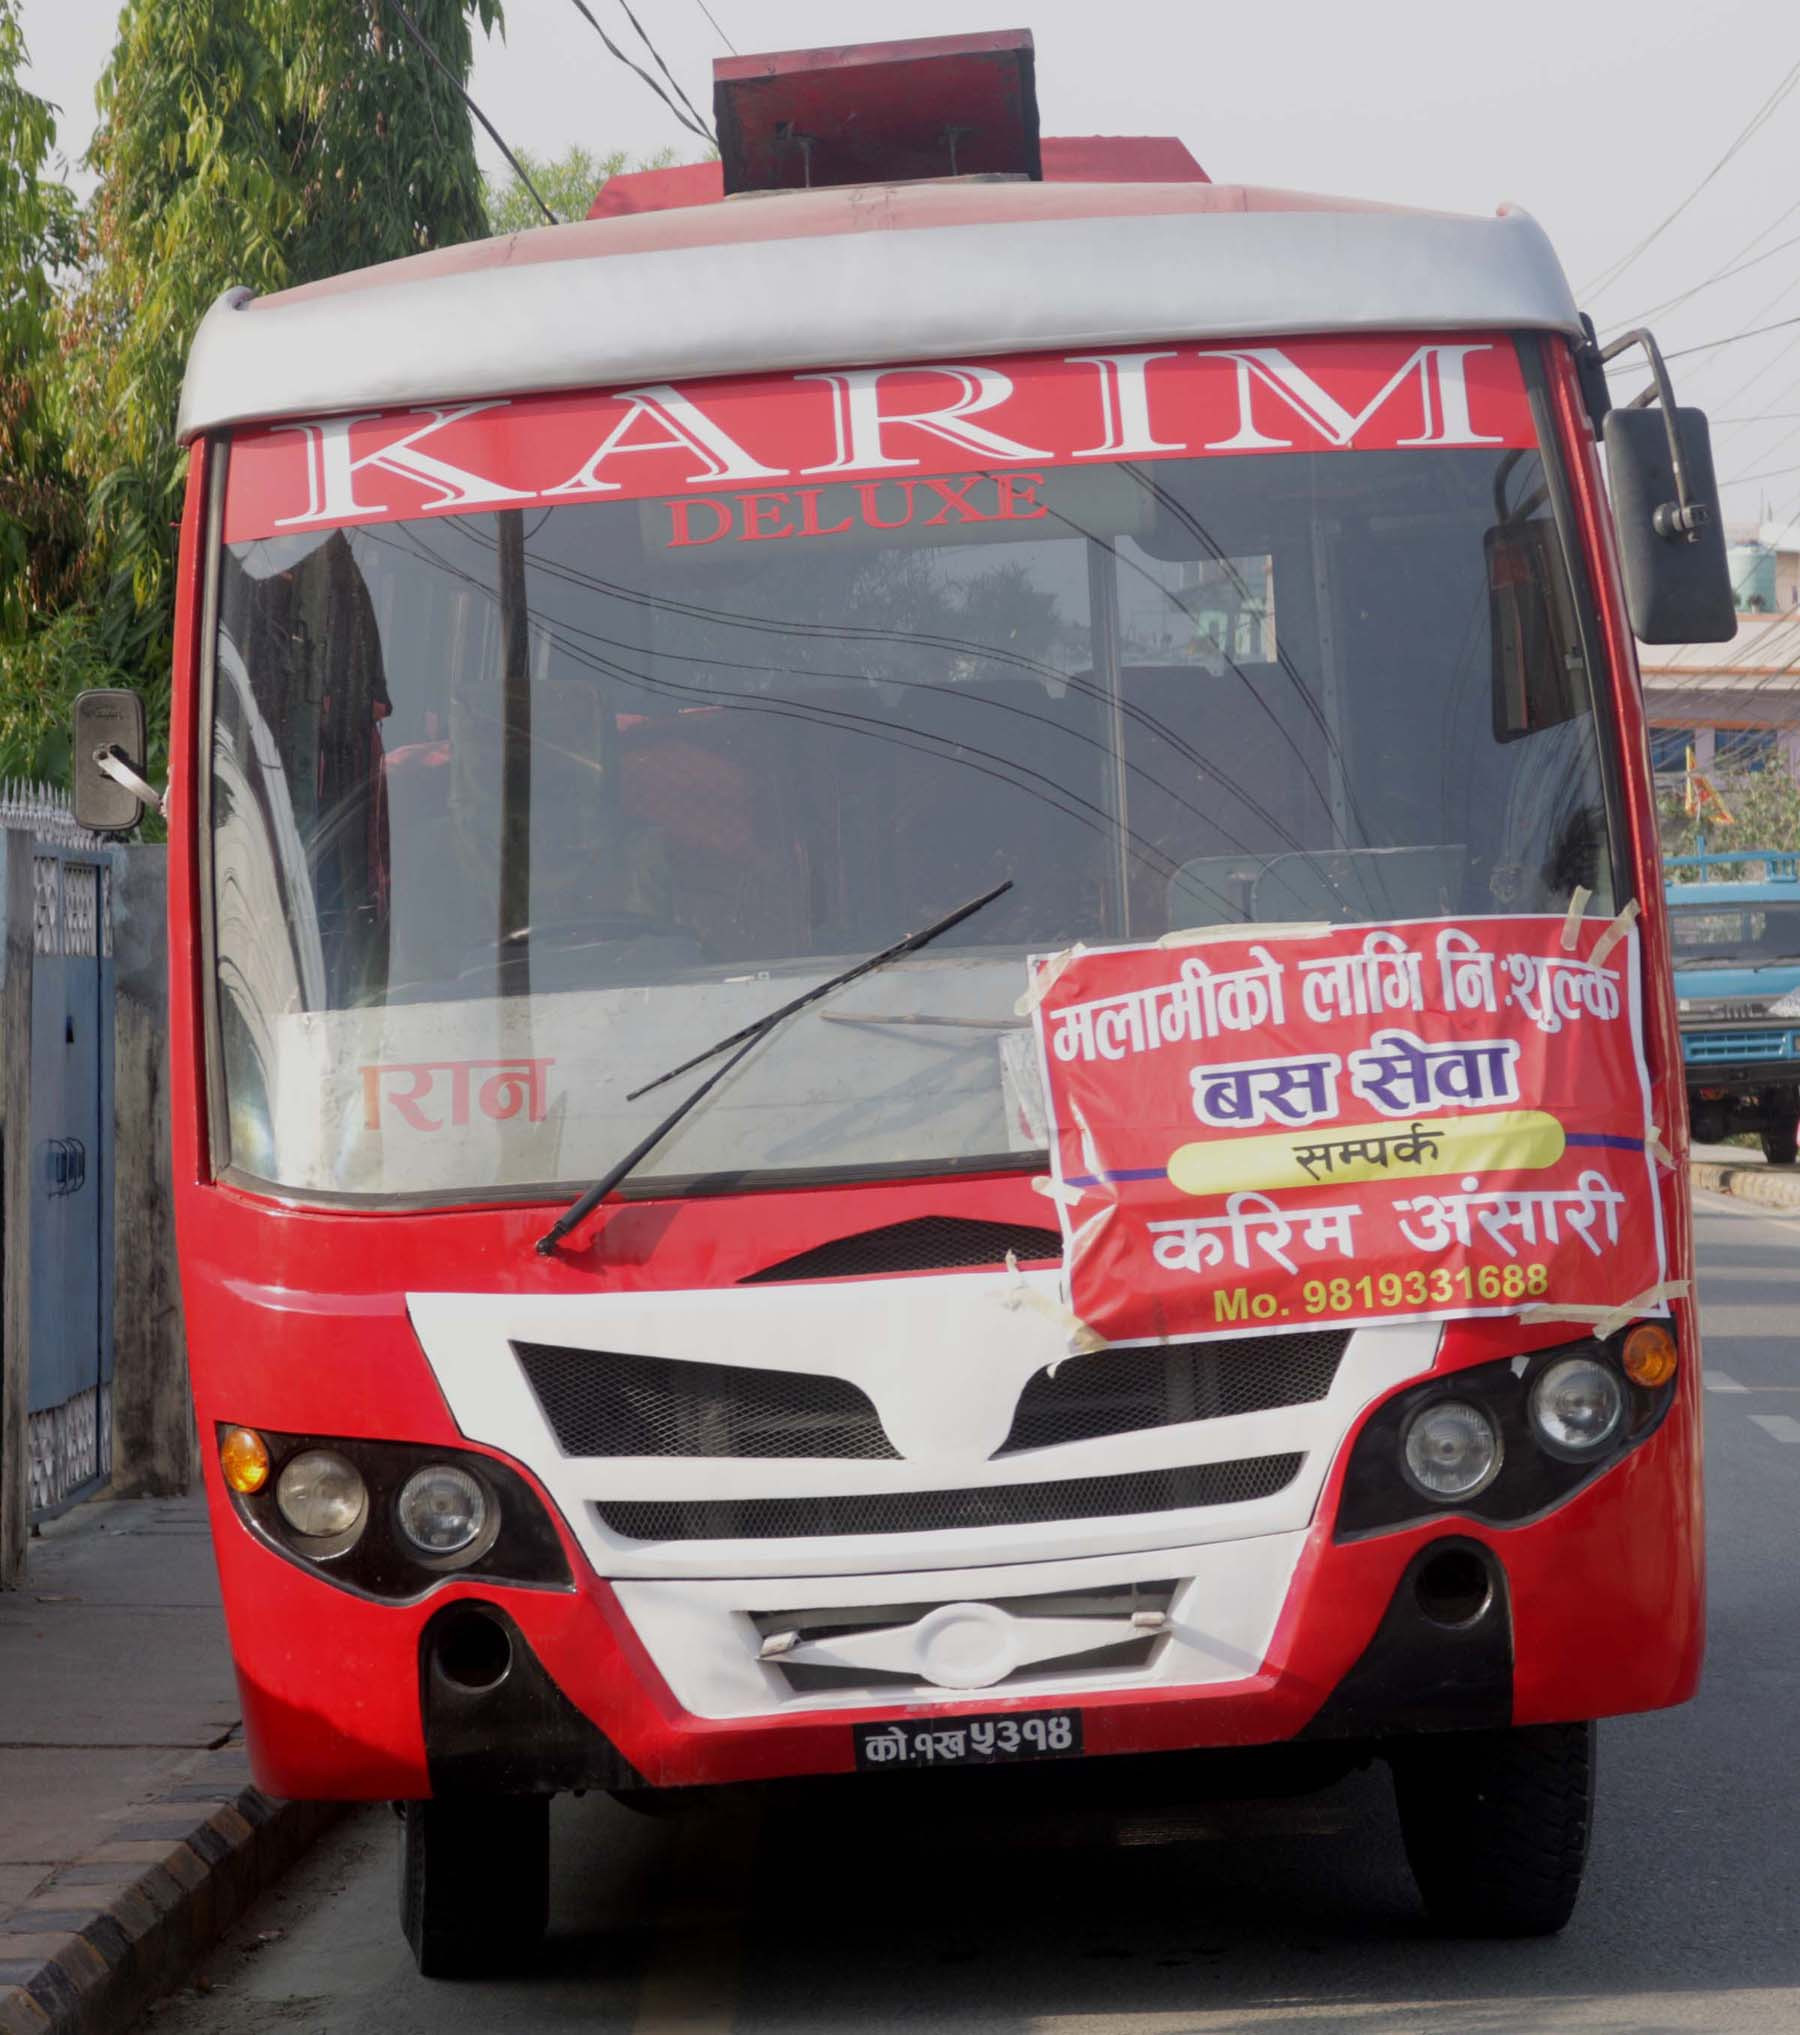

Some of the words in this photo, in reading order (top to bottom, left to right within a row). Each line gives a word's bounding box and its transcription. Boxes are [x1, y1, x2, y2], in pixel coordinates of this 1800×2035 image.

[271, 344, 1505, 528] KARIM
[666, 472, 1050, 549] DELUXE
[1050, 945, 1284, 1062] मलामीको
[1298, 931, 1423, 1023] लागि
[1200, 1059, 1332, 1121] बस
[1359, 1037, 1510, 1112] सेवा
[1294, 1123, 1445, 1182] सम्पर्क
[1148, 1192, 1362, 1274] करिम
[1393, 1170, 1625, 1258] अंसारी
[1213, 1287, 1291, 1323] Mo.
[1302, 1263, 1549, 1314] 9819331688
